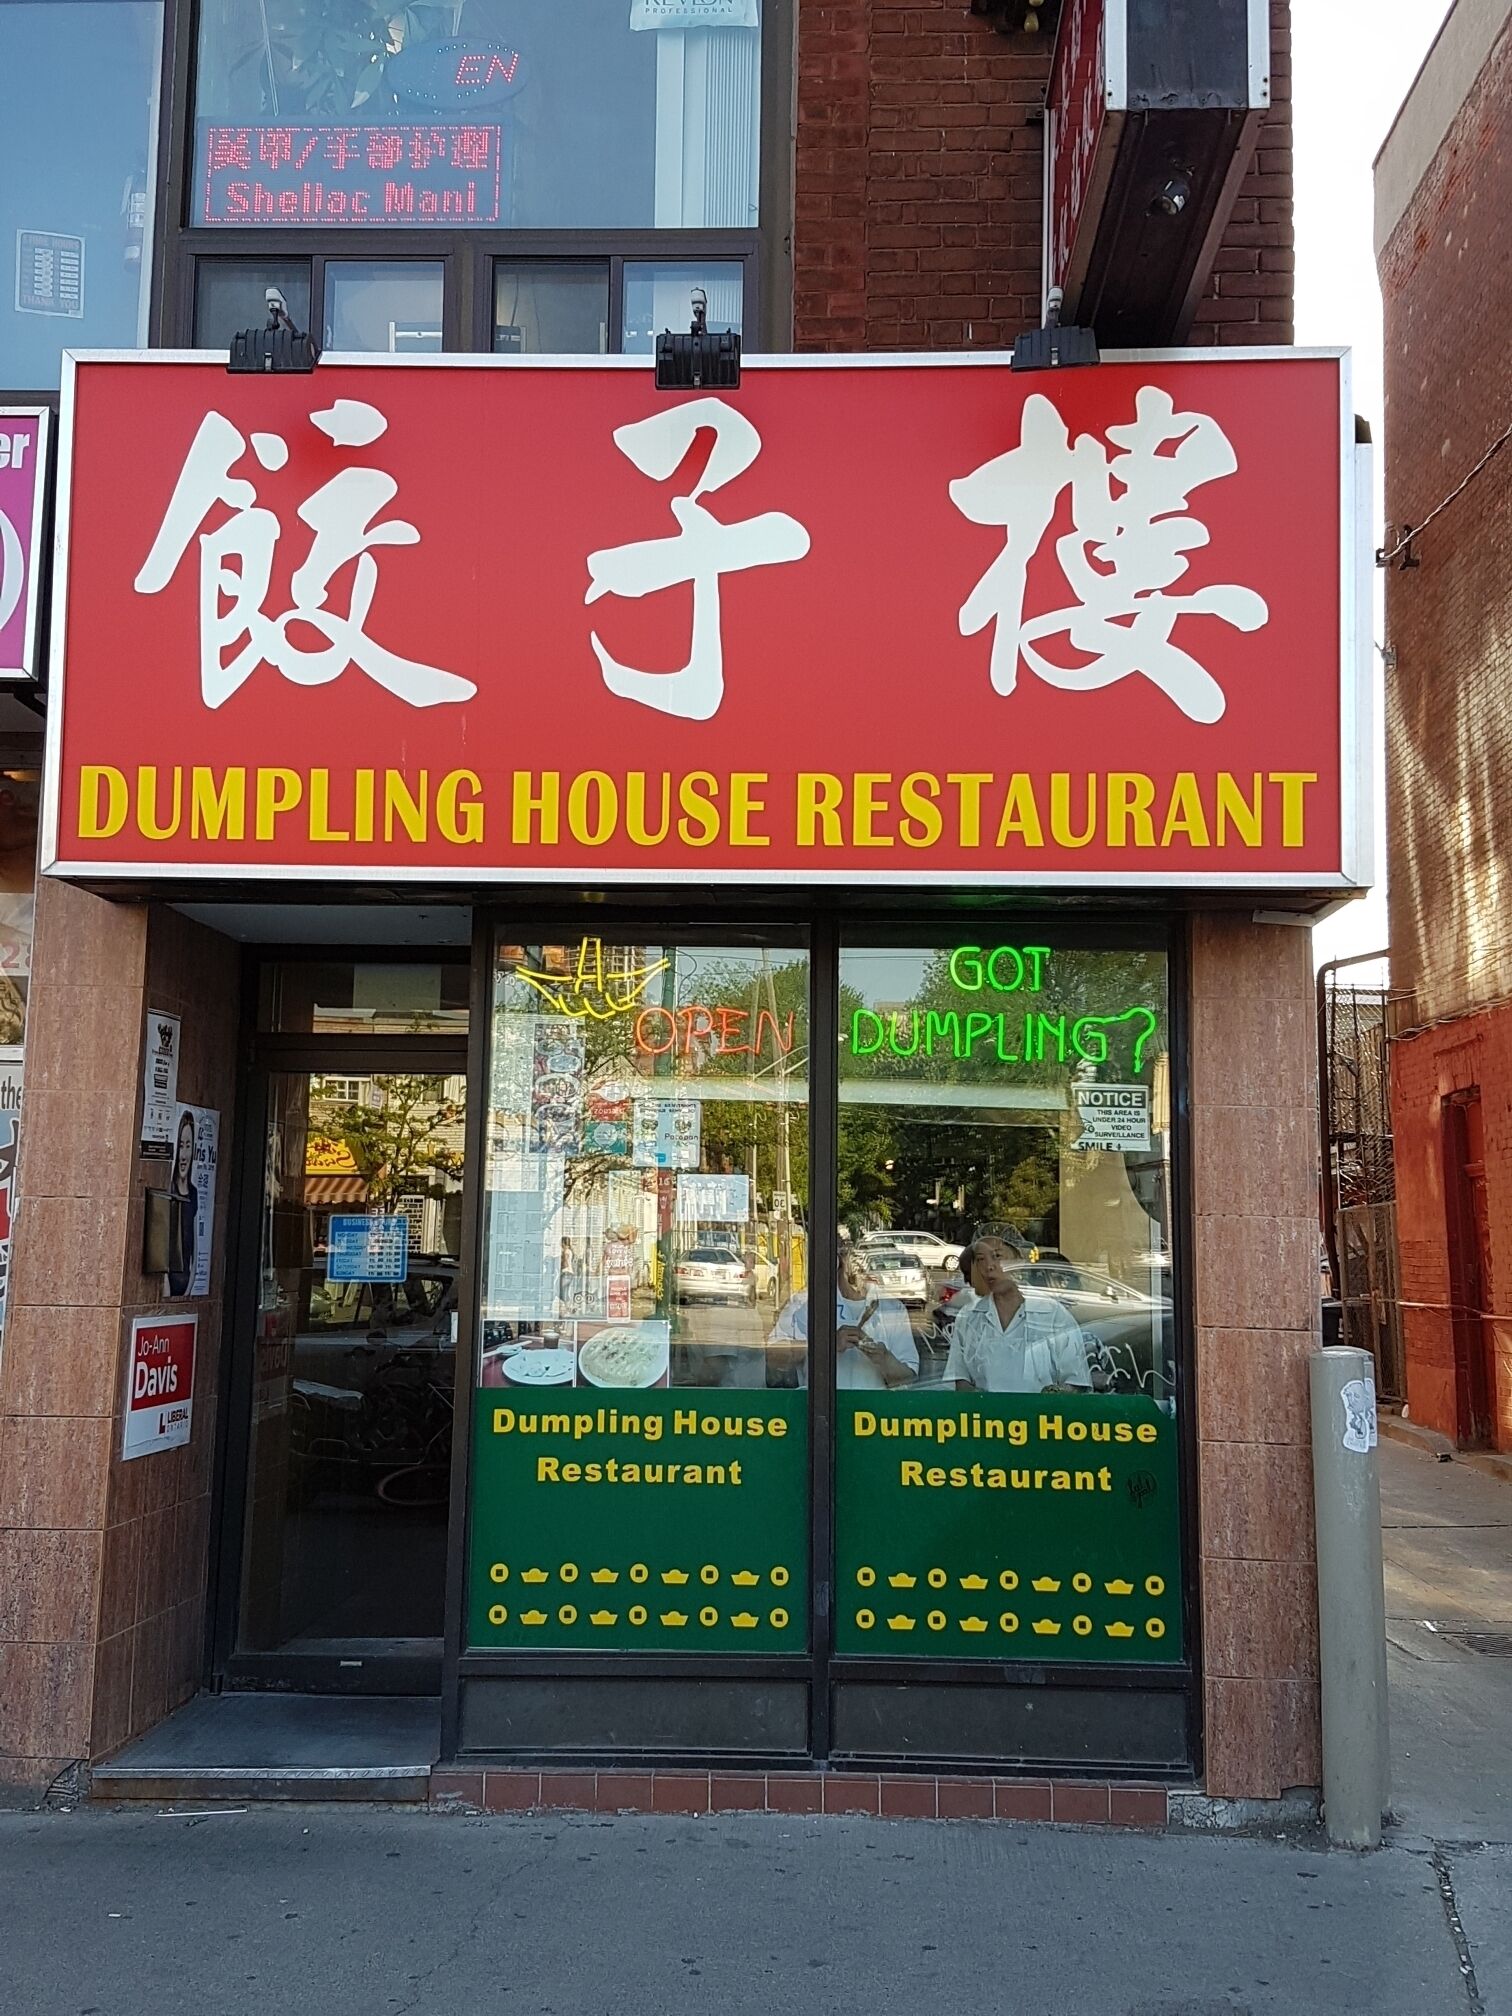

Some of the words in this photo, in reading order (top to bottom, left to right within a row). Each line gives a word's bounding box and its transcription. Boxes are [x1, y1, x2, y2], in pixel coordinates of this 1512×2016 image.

[227, 181, 370, 213] Shellac
[384, 181, 475, 213] Mani
[77, 764, 484, 845] DUMPLING
[510, 769, 772, 848] HOUSE
[795, 771, 1319, 849] RESTAURANT
[949, 946, 1051, 992] GOT
[635, 1006, 795, 1055] OPEN
[1078, 1091, 1143, 1107] NOTICE
[1078, 1141, 1113, 1151] SMILE
[1094, 1131, 1145, 1139] SURVEILLANCE
[208, 1144, 217, 1164] Yu
[137, 1334, 170, 1357] Jo-Ann
[134, 1355, 178, 1399] Davis
[167, 1408, 189, 1424] LIBERAL
[493, 1408, 663, 1441] Dumpling
[673, 1409, 788, 1436] House
[854, 1411, 1028, 1446] Dumpling
[1039, 1414, 1158, 1443] House
[537, 1456, 743, 1485] Restaurant
[901, 1461, 1112, 1491] Restaurant
